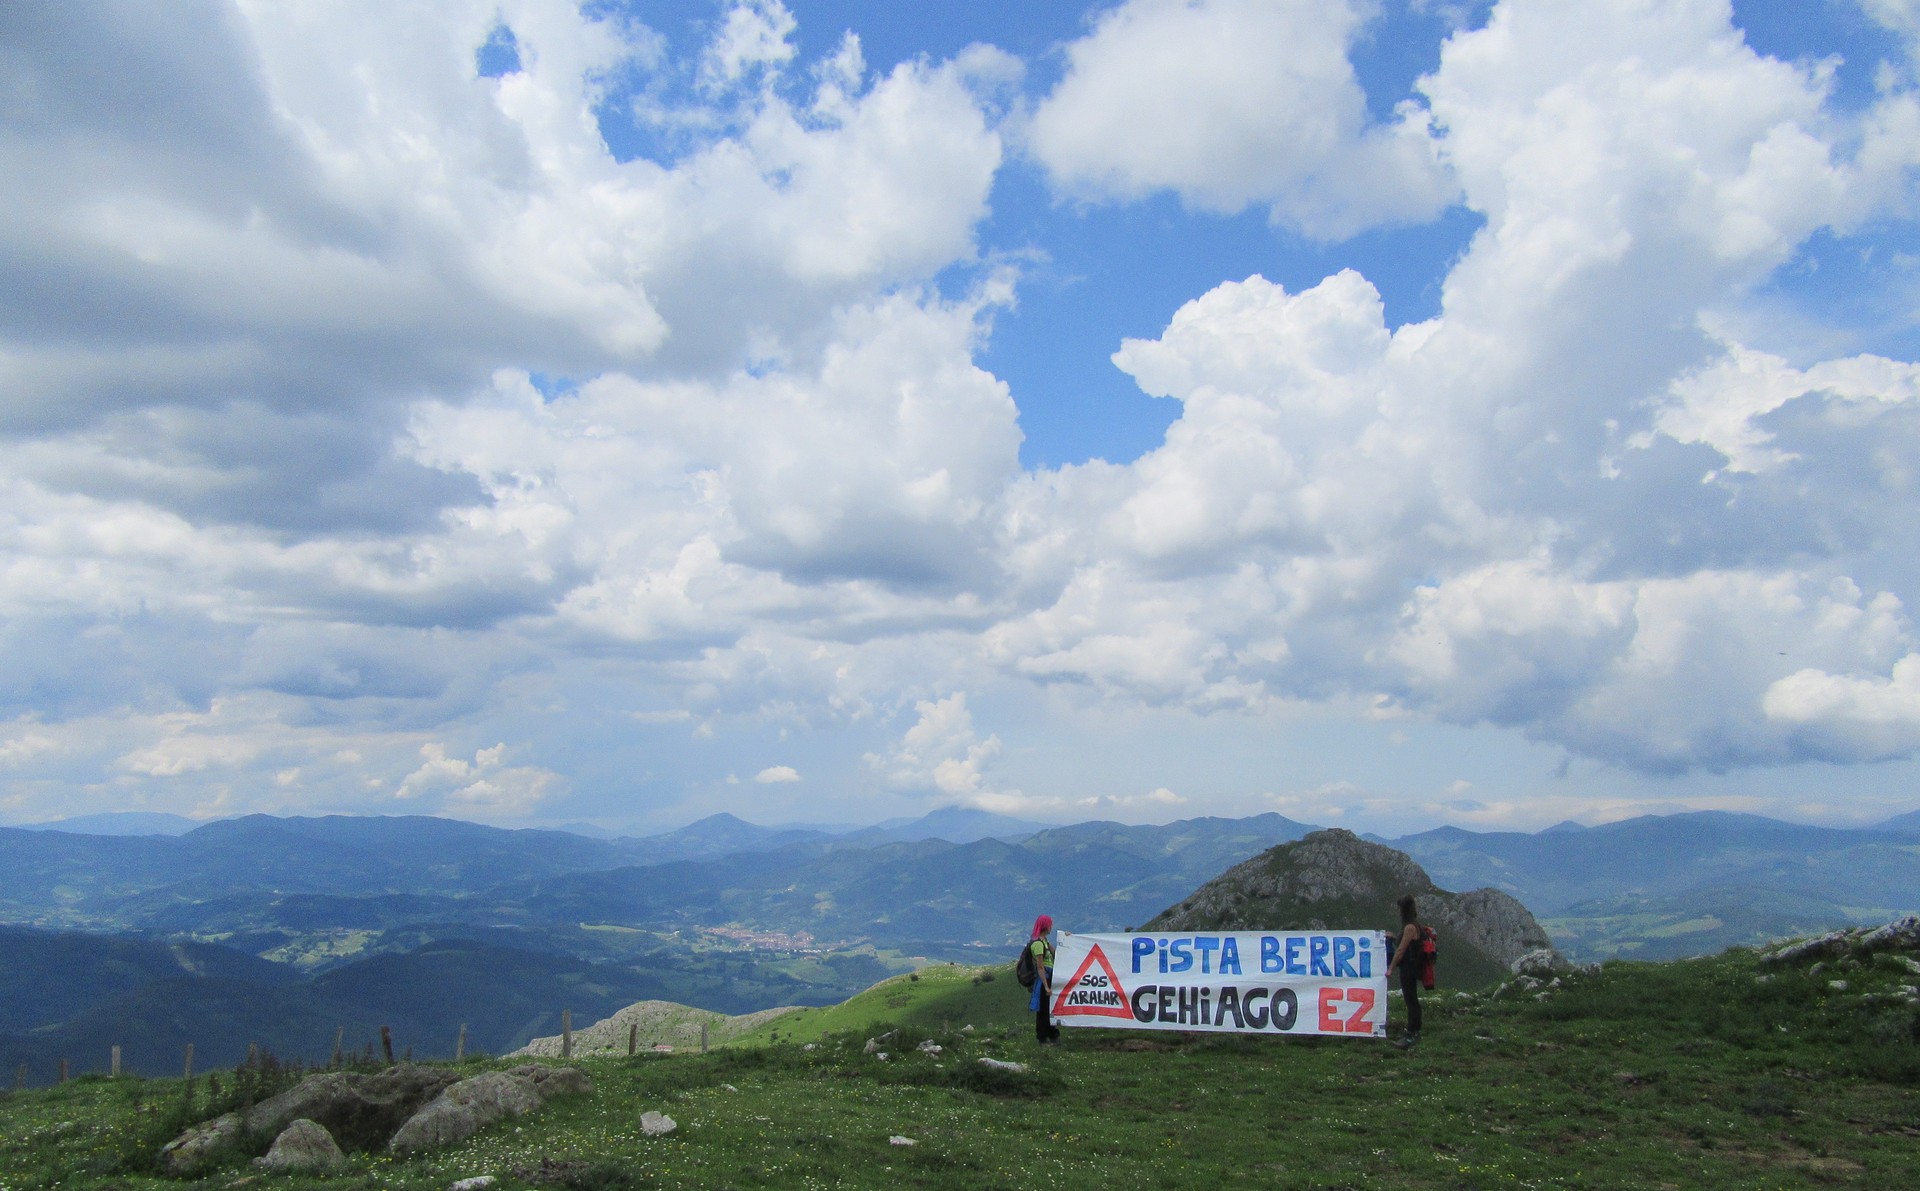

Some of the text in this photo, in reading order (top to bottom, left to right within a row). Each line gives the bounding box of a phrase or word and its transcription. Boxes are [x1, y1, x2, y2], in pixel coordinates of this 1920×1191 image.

[1079, 974, 1108, 988] SOS
[1067, 988, 1120, 1006] ARALAR
[1317, 986, 1375, 1033] EZ
